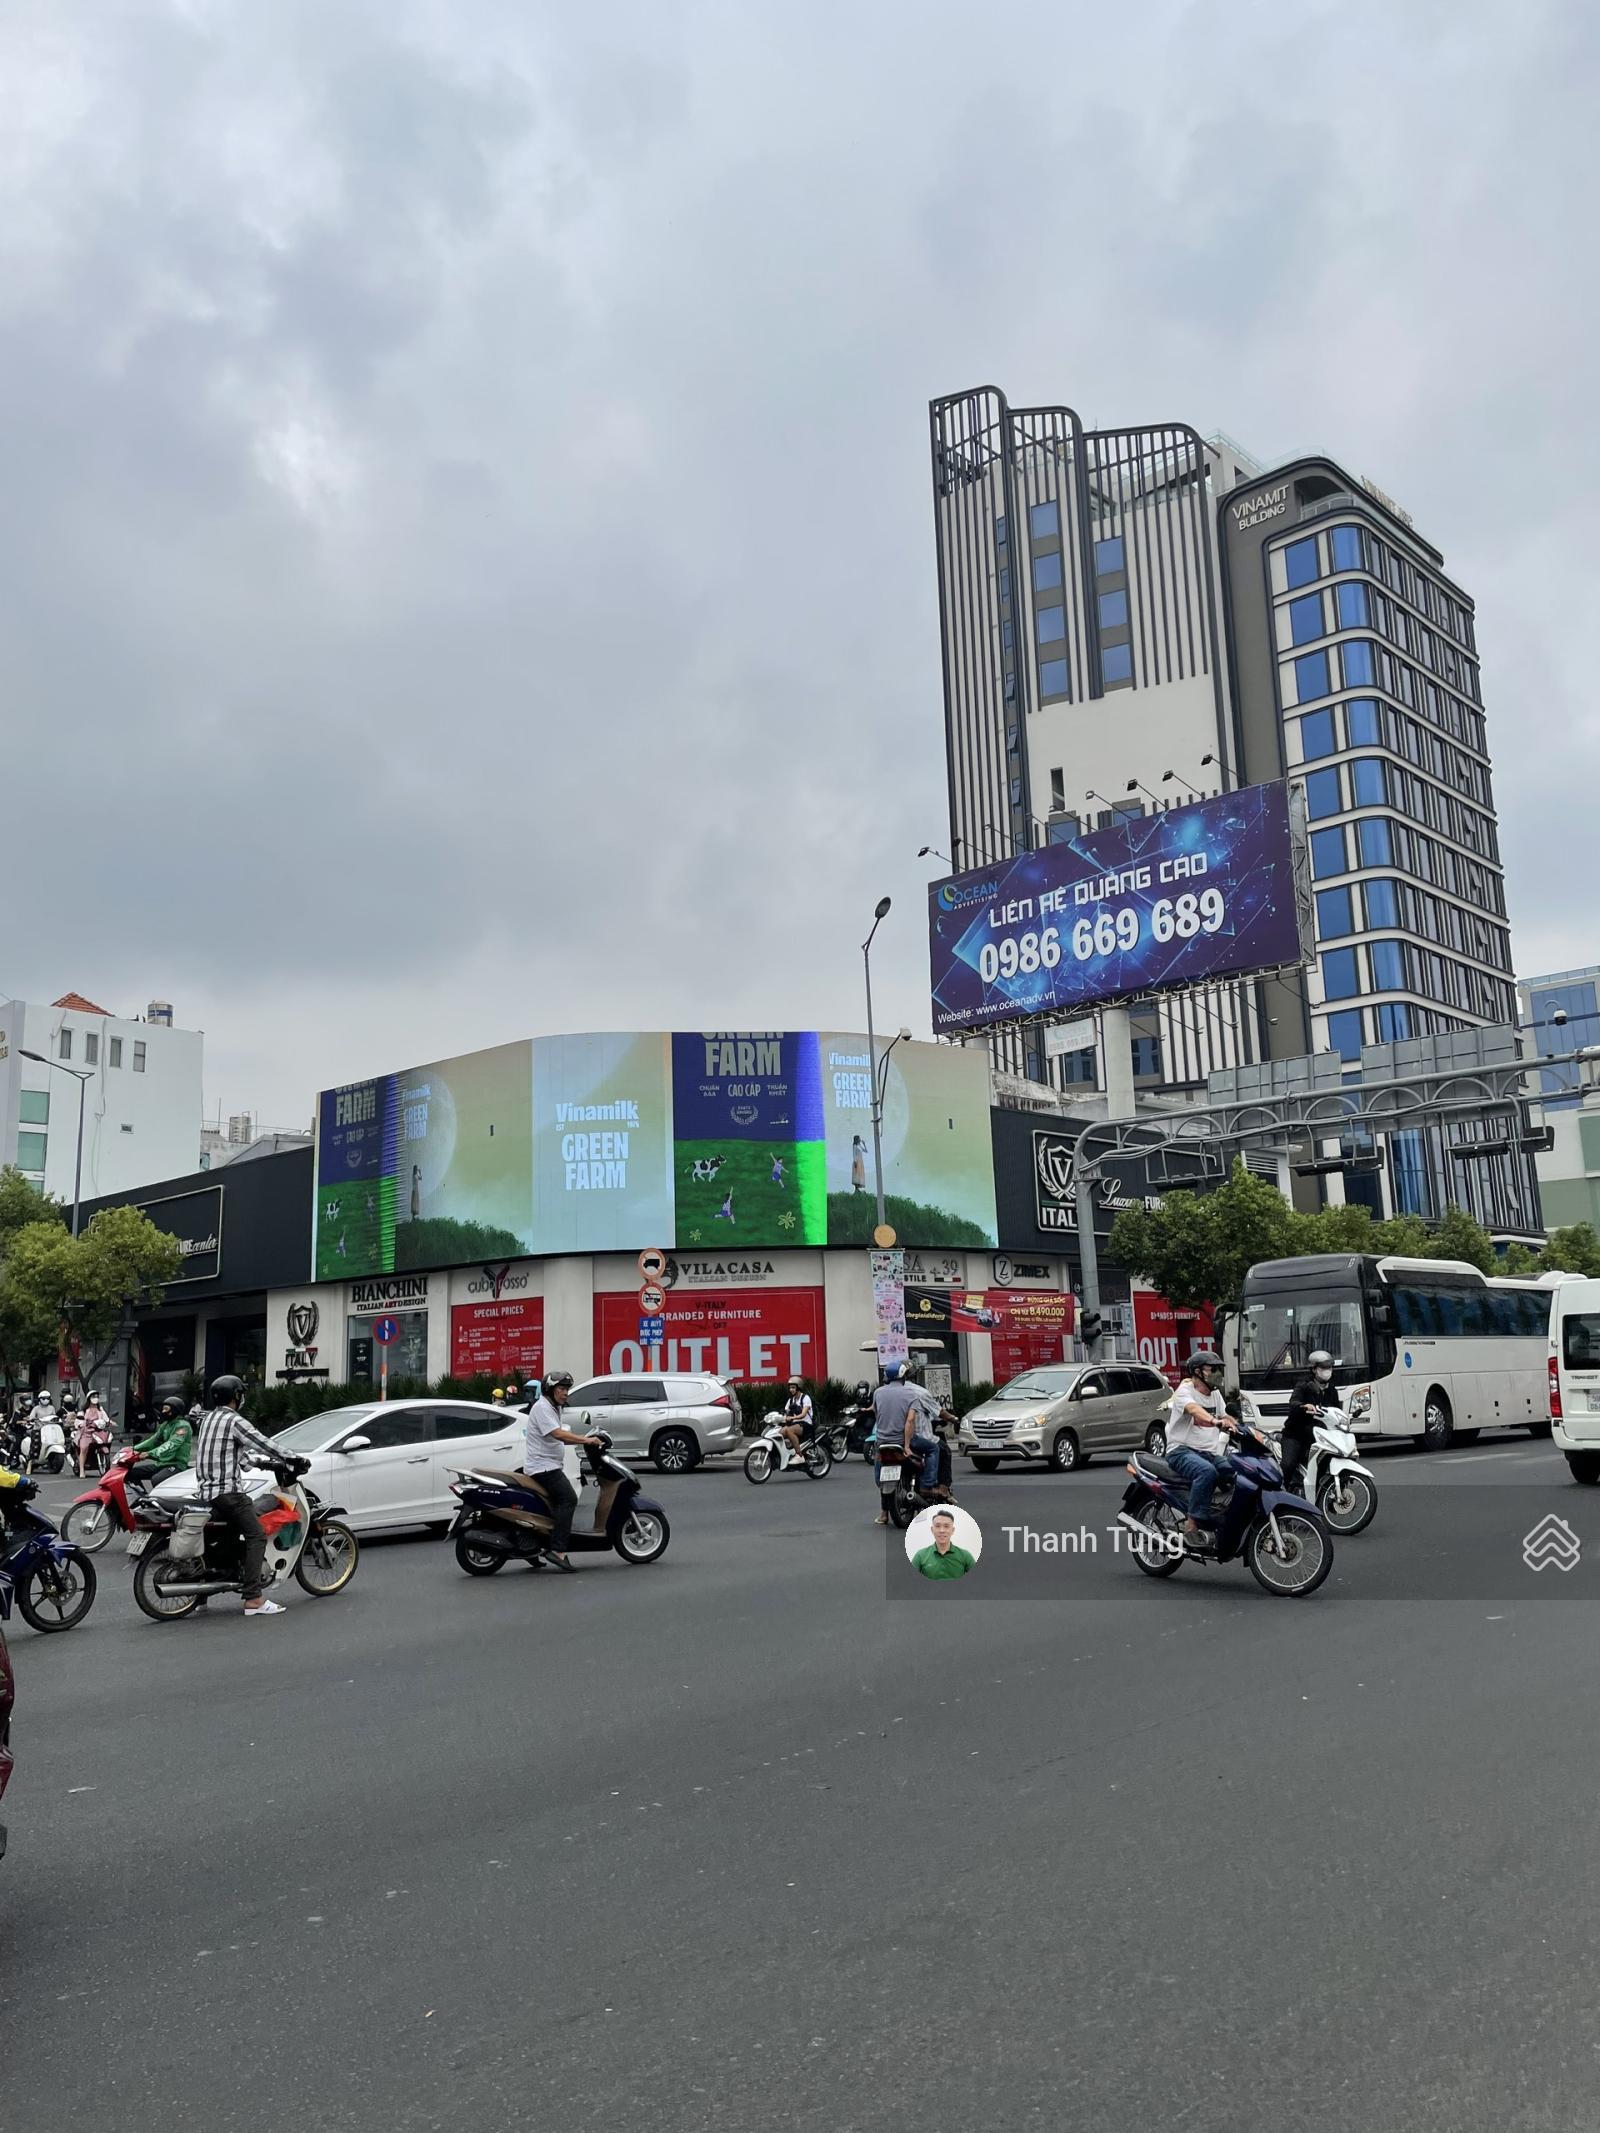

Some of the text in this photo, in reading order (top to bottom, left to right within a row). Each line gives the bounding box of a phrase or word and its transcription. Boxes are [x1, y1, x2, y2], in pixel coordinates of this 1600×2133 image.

[1232, 484, 1289, 519] VINAMIT
[1239, 503, 1286, 530] BUILDING
[953, 881, 998, 901] OCEAN
[989, 899, 1033, 928] LIÊN
[1075, 865, 1152, 906] QUẢNG
[1160, 853, 1208, 884] CÁO
[953, 893, 999, 910] ADVERTISING
[979, 888, 1224, 983] 0986 669 689
[937, 991, 1056, 1024] Website: www.oceanadv.vn
[705, 1041, 781, 1077] FARM
[828, 1051, 871, 1067] Vinamil
[728, 1084, 743, 1097] CAO
[833, 1072, 872, 1091] GREEN
[835, 1090, 871, 1109] FARM
[555, 1100, 640, 1122] Vinamilk
[561, 1132, 629, 1161] GREEN
[565, 1160, 626, 1190] FARM
[1042, 1207, 1078, 1228] ITAL
[680, 1261, 775, 1276] VILACASA
[1013, 1264, 1050, 1279] ZIMEX
[351, 1277, 428, 1303] BIANCHINI
[356, 1303, 384, 1312] ITALIAN
[397, 1297, 427, 1307] DESIGN
[474, 1305, 524, 1318] SPECIAL PRICES
[1030, 1307, 1065, 1316] 8.490.000
[659, 1309, 762, 1321] BRANDED FURNITURE
[285, 1352, 318, 1368] ITALY
[609, 1333, 810, 1377] OUTLET
